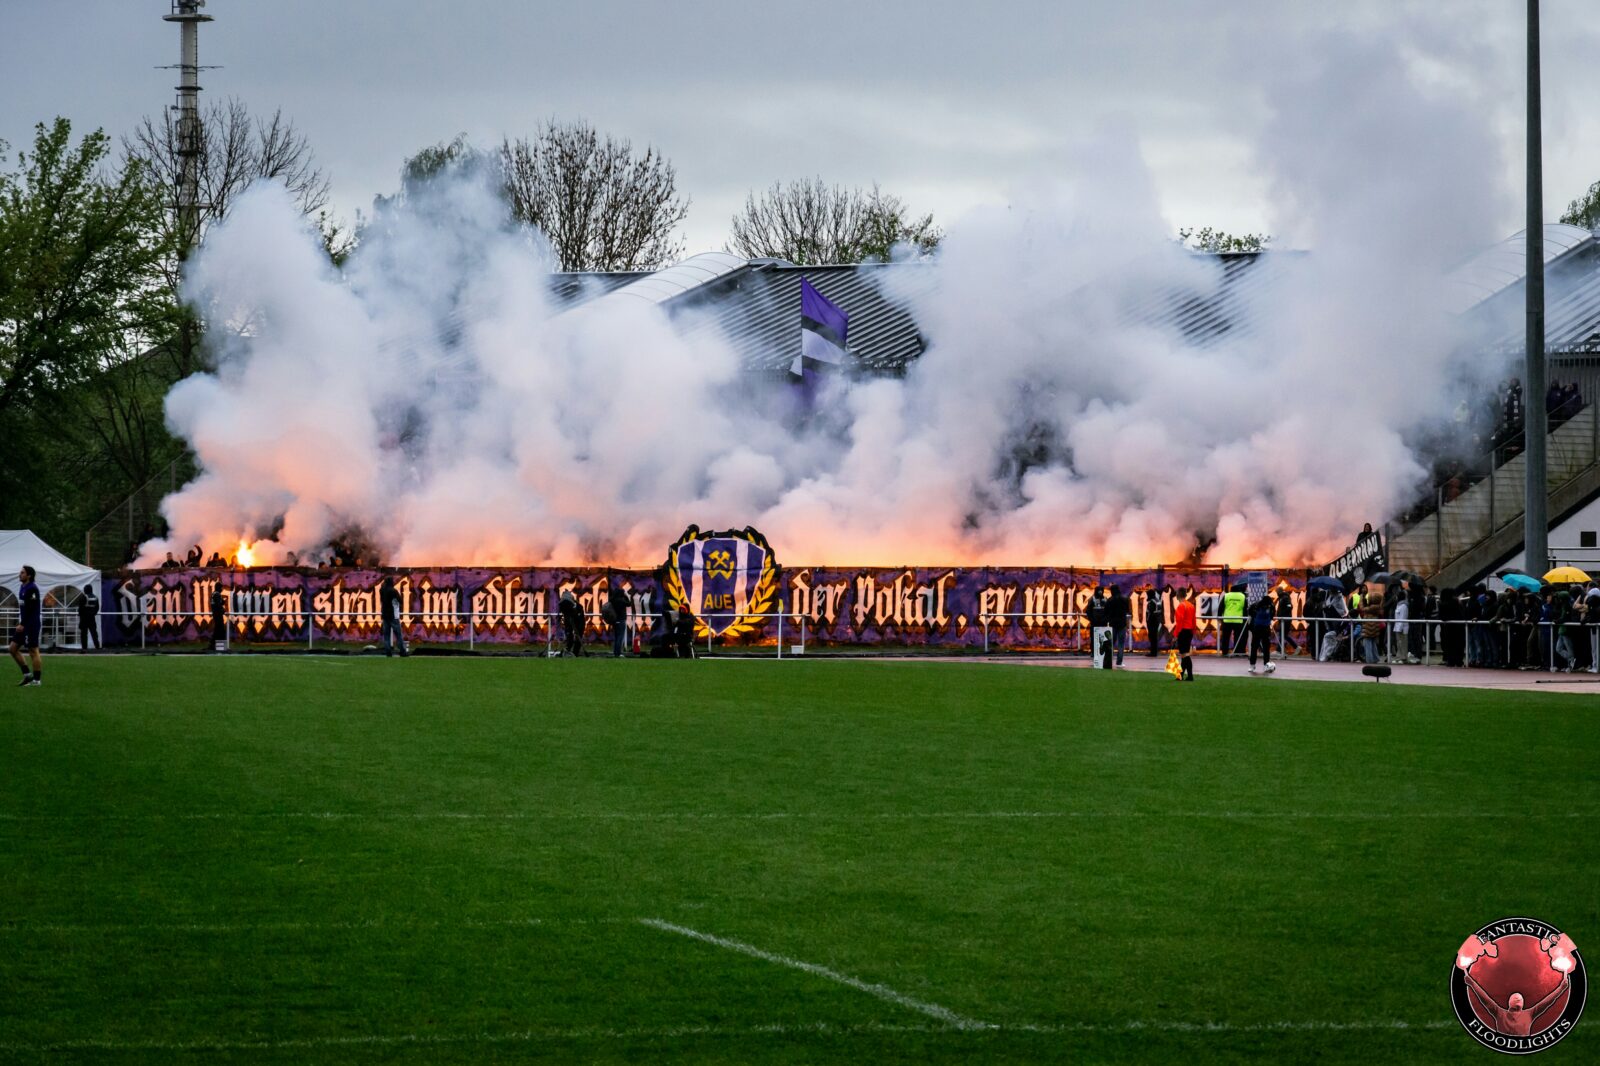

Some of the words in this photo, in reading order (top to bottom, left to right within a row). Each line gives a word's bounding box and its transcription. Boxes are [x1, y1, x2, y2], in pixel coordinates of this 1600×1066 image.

[313, 576, 414, 629] strat
[422, 580, 463, 630] im
[472, 575, 549, 630] edlen
[559, 576, 656, 631] chin
[703, 593, 734, 610] AUE
[980, 583, 1017, 629] er
[1023, 582, 1112, 631] mus
